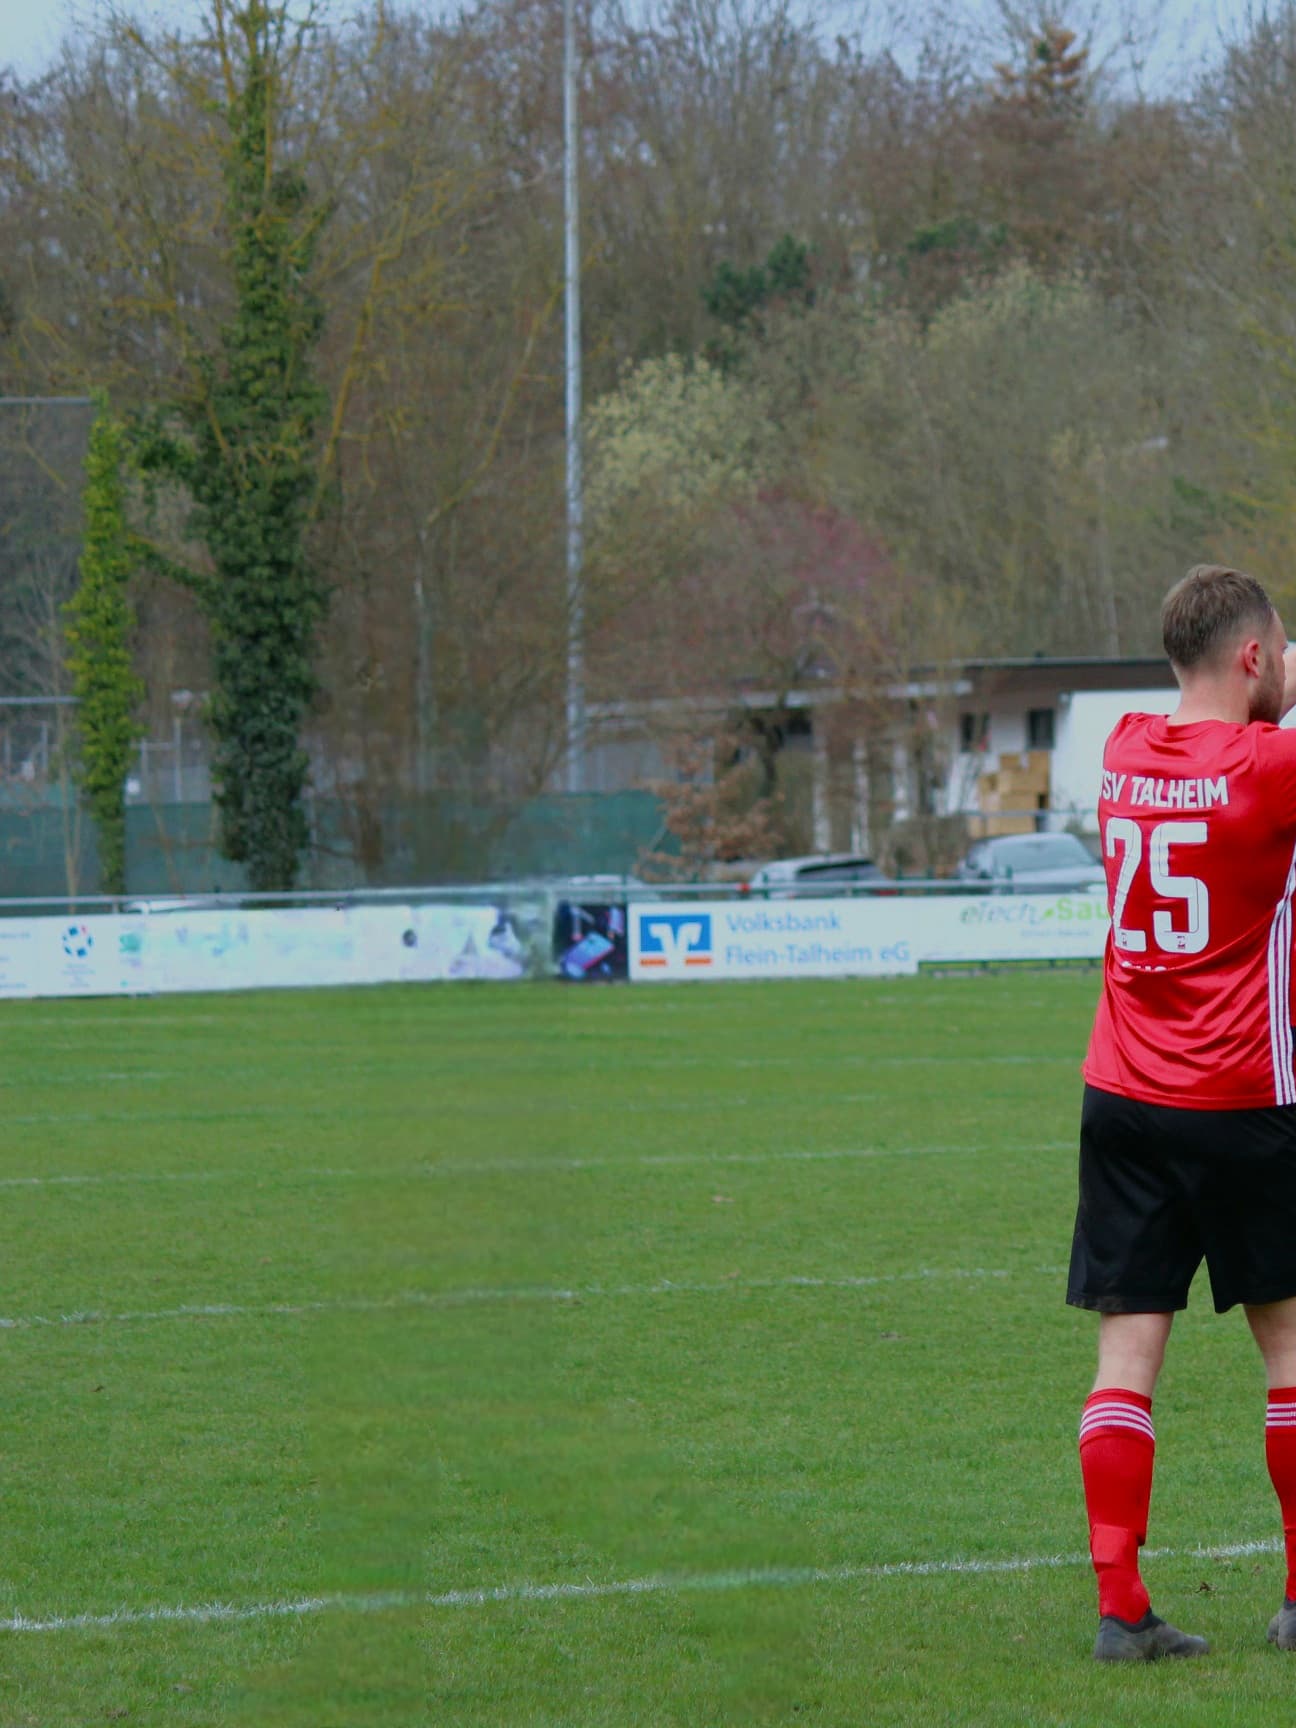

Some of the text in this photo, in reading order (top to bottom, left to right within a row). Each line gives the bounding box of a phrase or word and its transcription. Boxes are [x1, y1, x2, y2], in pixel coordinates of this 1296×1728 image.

[1101, 770, 1229, 808] SV TALHEIM
[1106, 816, 1210, 954] 25
[726, 911, 841, 934] Volksbank
[726, 941, 911, 965] Flein-Talheim eG
